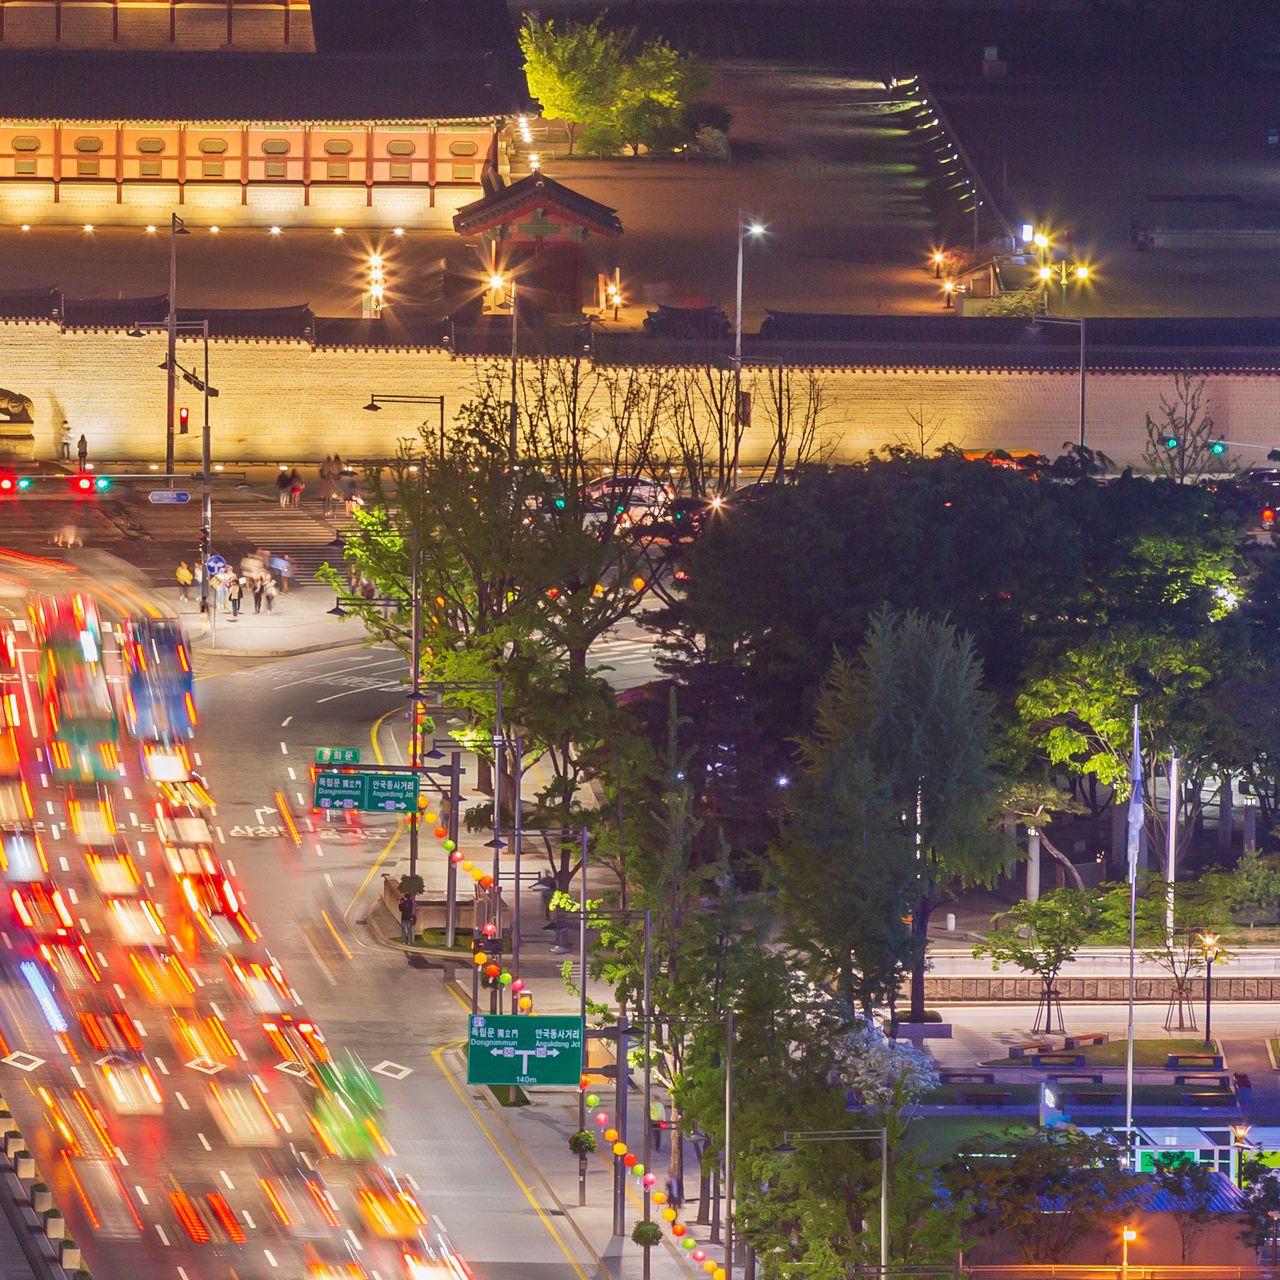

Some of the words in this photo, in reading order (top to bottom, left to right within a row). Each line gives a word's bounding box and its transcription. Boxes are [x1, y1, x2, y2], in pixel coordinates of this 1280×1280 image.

[319, 778, 340, 787] 독립문
[372, 780, 414, 790] 안국동사거리
[471, 1027, 495, 1038] 독립문
[535, 1029, 579, 1039] 안국동사거리
[471, 1039, 517, 1047] Dongnimmun
